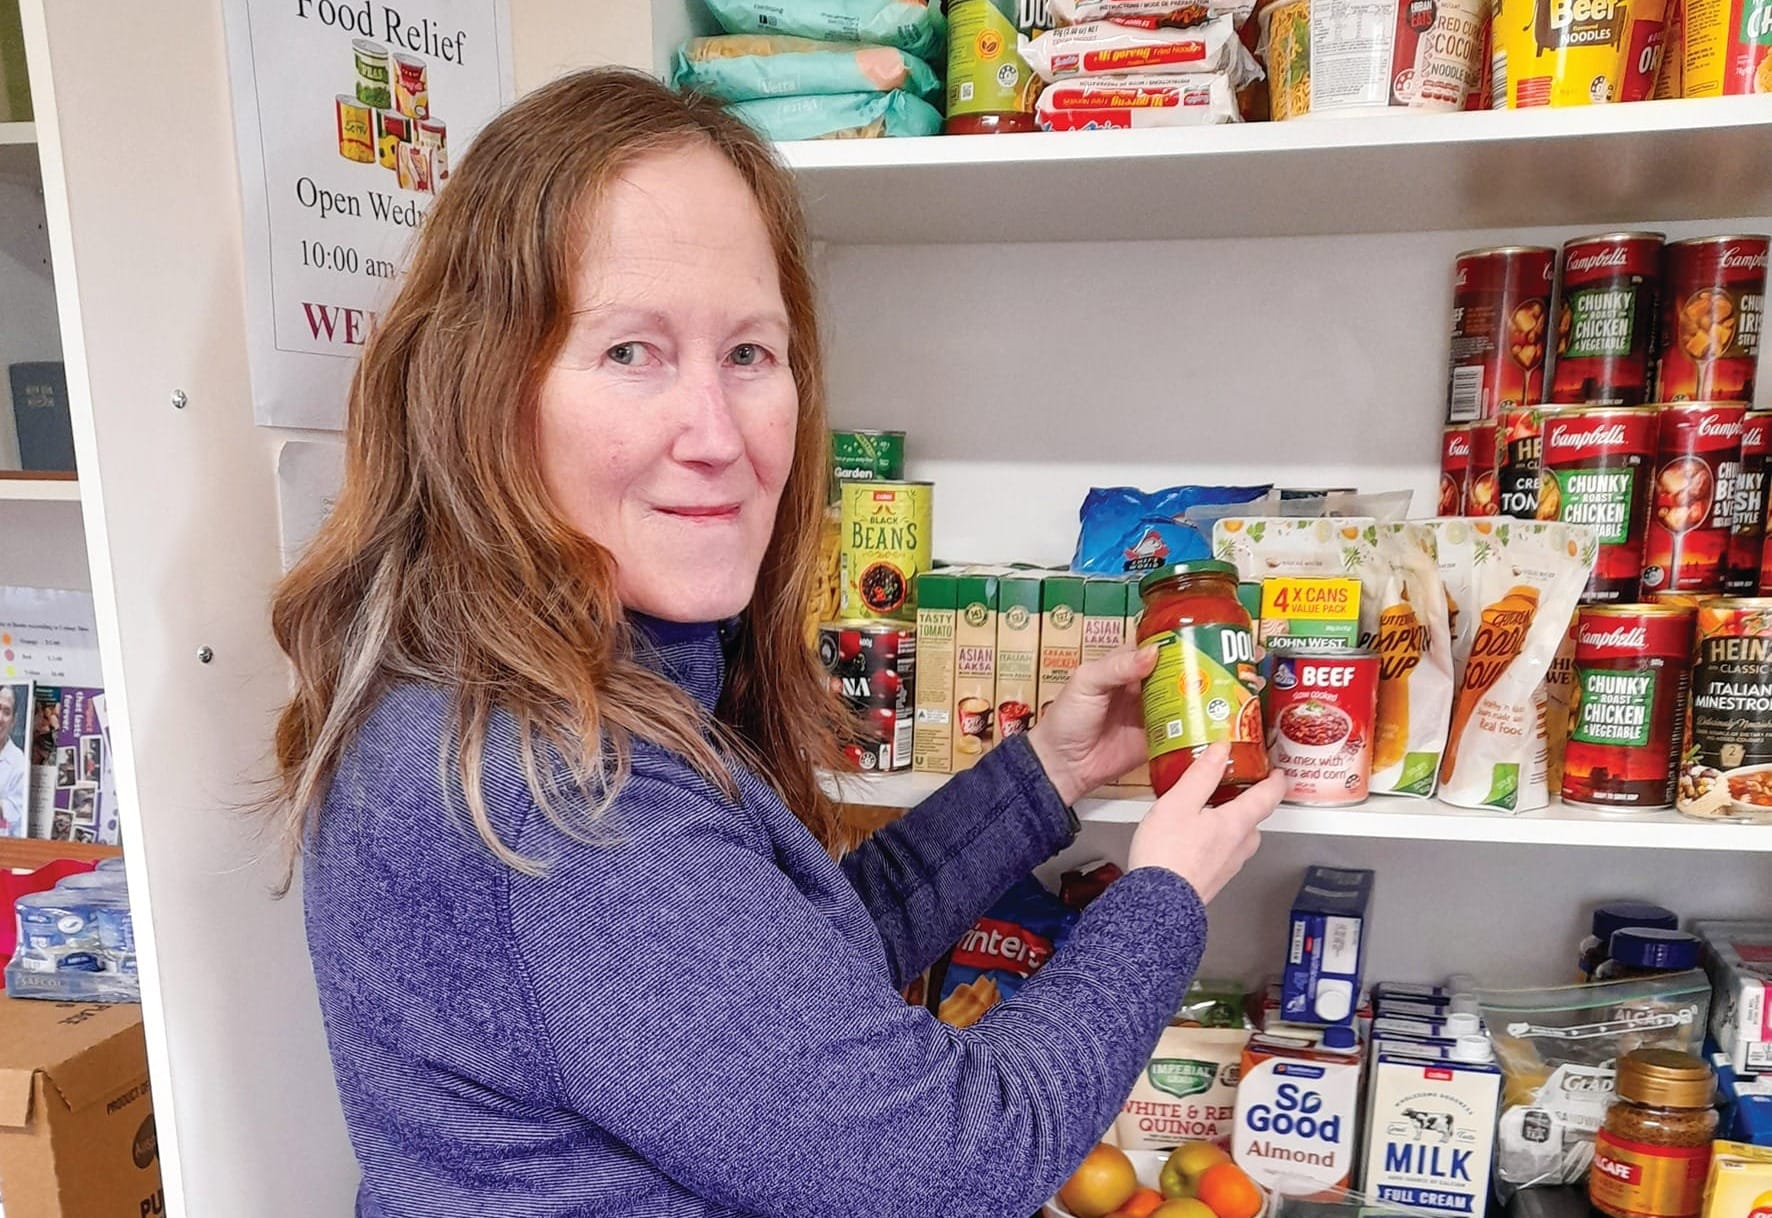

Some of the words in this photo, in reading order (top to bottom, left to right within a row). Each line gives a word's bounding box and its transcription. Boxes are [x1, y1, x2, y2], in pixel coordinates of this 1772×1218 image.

[1411, 12, 1432, 28] EATS
[1550, 0, 1619, 29] Beef
[296, 0, 375, 37] Food
[382, 6, 467, 65] Relief
[1437, 15, 1461, 33] RED
[1561, 29, 1612, 44] NOODLES
[1112, 48, 1150, 62] goreng
[296, 177, 362, 219] Open
[301, 240, 358, 273] 10:00
[366, 258, 396, 280] am
[1577, 292, 1632, 311] CHUNKY
[1576, 318, 1631, 338] CHICKEN
[834, 467, 873, 479] Garden
[1567, 474, 1630, 494] CHUNKY
[870, 516, 899, 525] BLACK
[1564, 502, 1626, 523] CHICKEN
[852, 521, 917, 550] BEANS
[1273, 587, 1290, 613] 4
[1306, 588, 1348, 603] CANS
[1291, 603, 1321, 613] VALUE
[1323, 604, 1347, 614] PACK
[919, 614, 952, 624] TASTY
[1085, 620, 1120, 635] ASIAN
[919, 624, 952, 638] TOMATO
[1268, 636, 1307, 649] JOHN
[1307, 637, 1347, 649] WEST
[1710, 638, 1772, 663] HEIN
[959, 648, 992, 663] ASIAN
[1302, 666, 1355, 687] BEEF
[1719, 663, 1769, 675] CLASSIC
[1587, 674, 1650, 695] CHUNKY
[1601, 694, 1632, 704] ROAST
[1695, 695, 1772, 712] MINESTRO
[1583, 704, 1645, 725] CHICKEN
[1589, 723, 1643, 740] VEGETABLE
[1318, 754, 1344, 767] with
[1300, 769, 1320, 779] and
[1323, 769, 1346, 779] corn
[1151, 1063, 1211, 1078] IMPERIAL
[1275, 1083, 1322, 1114] So
[1187, 1104, 1199, 1119] &
[1139, 1117, 1218, 1137] QUINOA
[1246, 1103, 1341, 1144] Good
[1246, 1140, 1335, 1168] Almond
[1384, 1142, 1475, 1182] MILK
[1384, 1187, 1414, 1203] FULL
[1419, 1192, 1467, 1209] CREAM
